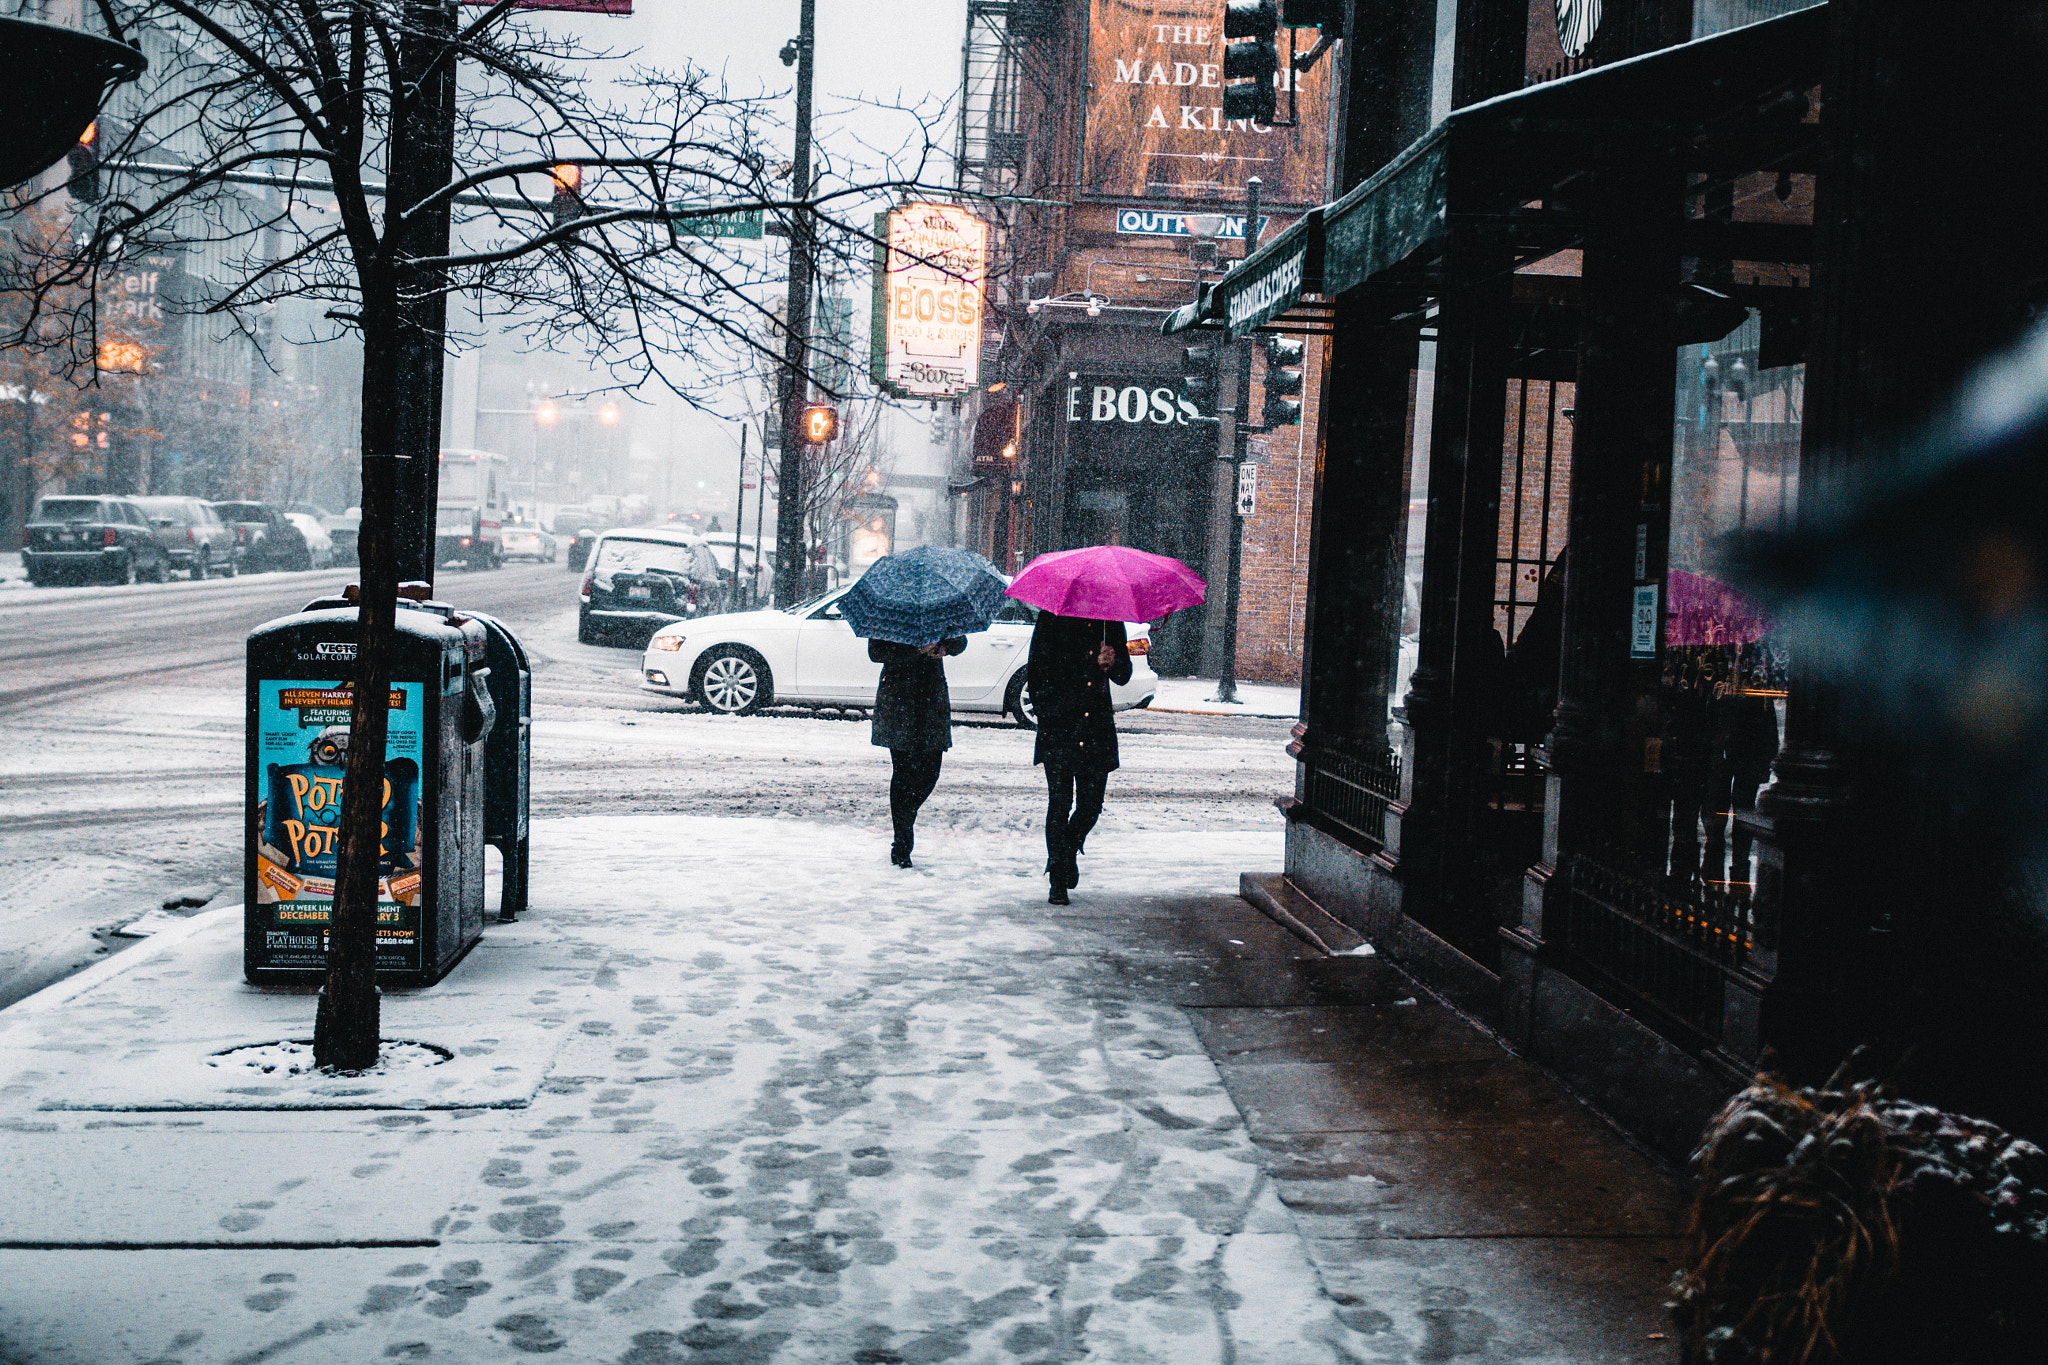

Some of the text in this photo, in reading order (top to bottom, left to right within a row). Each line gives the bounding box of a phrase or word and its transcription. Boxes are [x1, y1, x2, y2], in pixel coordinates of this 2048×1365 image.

[1152, 24, 1211, 45] THE
[1114, 58, 1221, 88] MADE
[1144, 104, 1170, 129] A
[727, 225, 735, 235] N
[1121, 211, 1248, 237] OUTFN
[118, 271, 159, 294] elf
[1229, 249, 1304, 329] STARBUCKS COFFEE
[894, 285, 976, 326] BOSS
[909, 361, 951, 385] Bar
[1091, 386, 1200, 426] BOSS
[1240, 467, 1255, 481] ONE
[1240, 481, 1255, 494] WAY
[320, 643, 358, 653] VECTO
[297, 653, 357, 661] SOLAR COMP
[322, 691, 347, 699] HARRY
[294, 698, 326, 706] SEVENTY
[285, 772, 392, 820] POT
[281, 819, 390, 865] POT
[296, 904, 319, 912] WEEK
[377, 905, 401, 913] EMENT
[279, 911, 329, 920] DECEMBER
[393, 913, 400, 922] 3
[266, 935, 318, 945] PLAYHOUSE
[392, 930, 414, 938] NOW!
